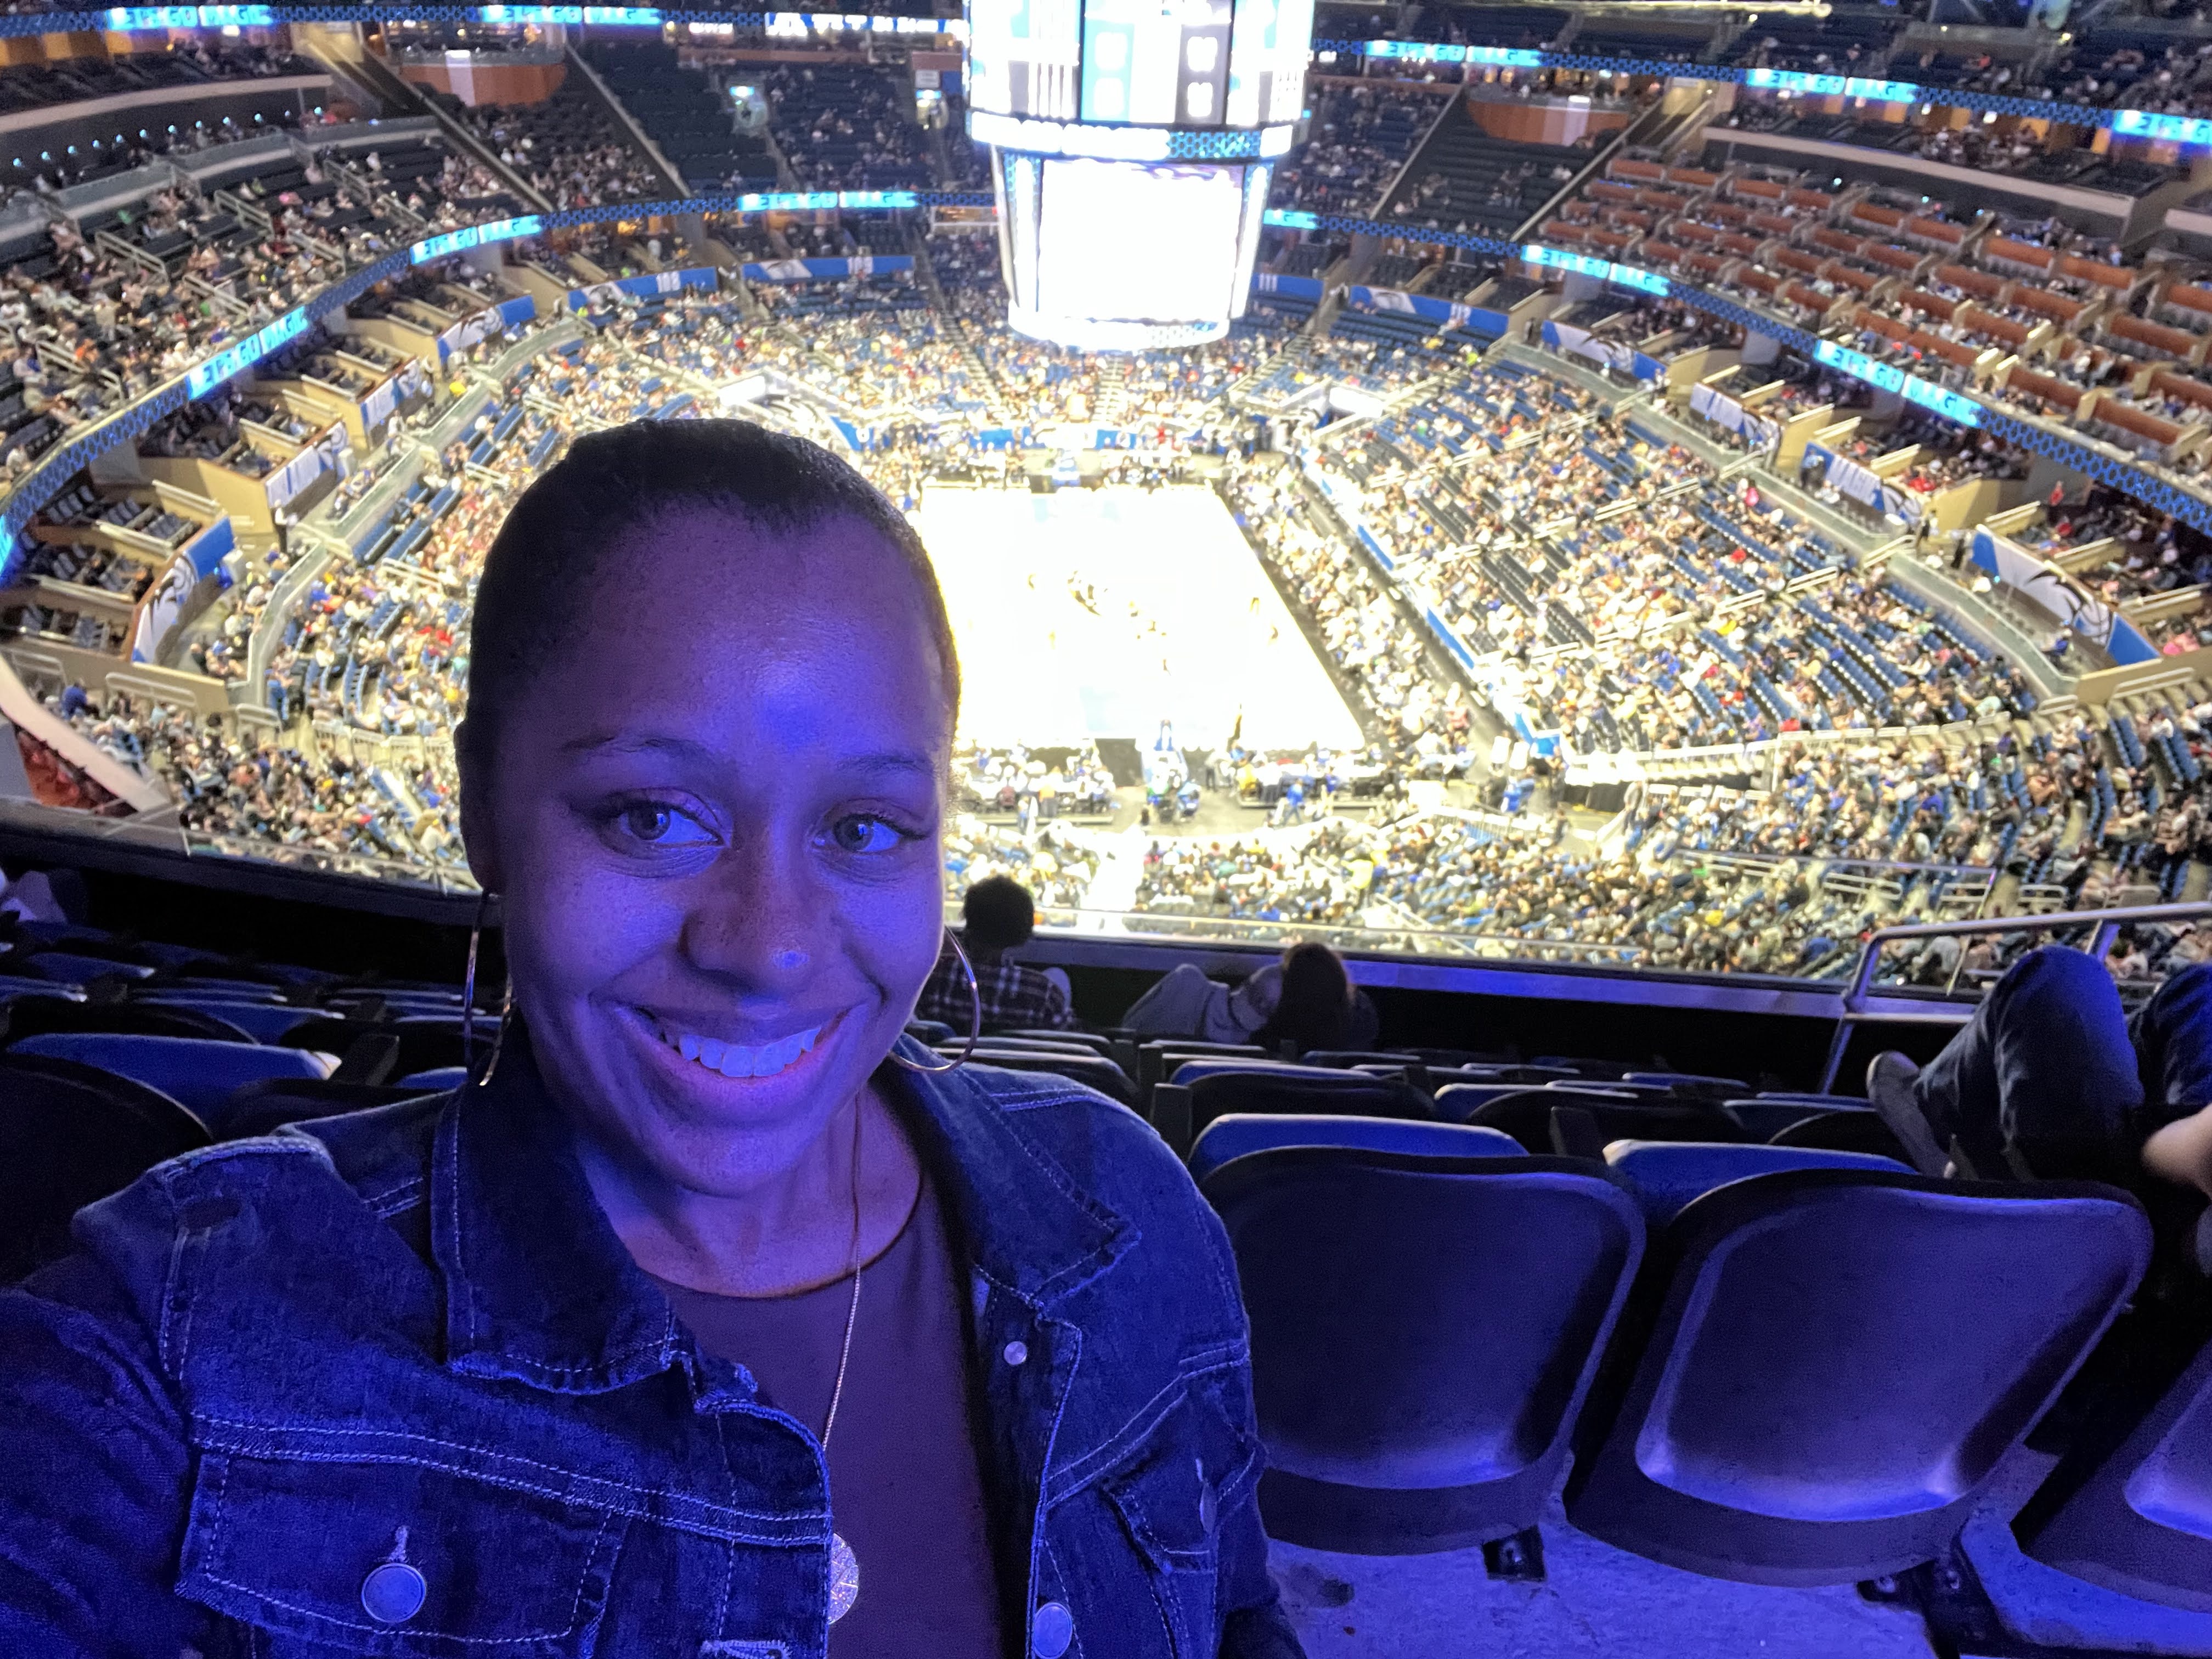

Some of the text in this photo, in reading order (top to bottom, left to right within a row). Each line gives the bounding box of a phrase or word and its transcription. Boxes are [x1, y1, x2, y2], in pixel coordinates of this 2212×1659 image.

[165, 5, 197, 26] GO
[549, 6, 583, 23] GO
[1433, 44, 1466, 61] GO
[1813, 74, 1846, 95] GO
[806, 192, 837, 208] GO
[453, 227, 478, 247] GO
[1584, 257, 1611, 279] GO
[235, 333, 261, 364] GO
[1872, 362, 1904, 392] GO
